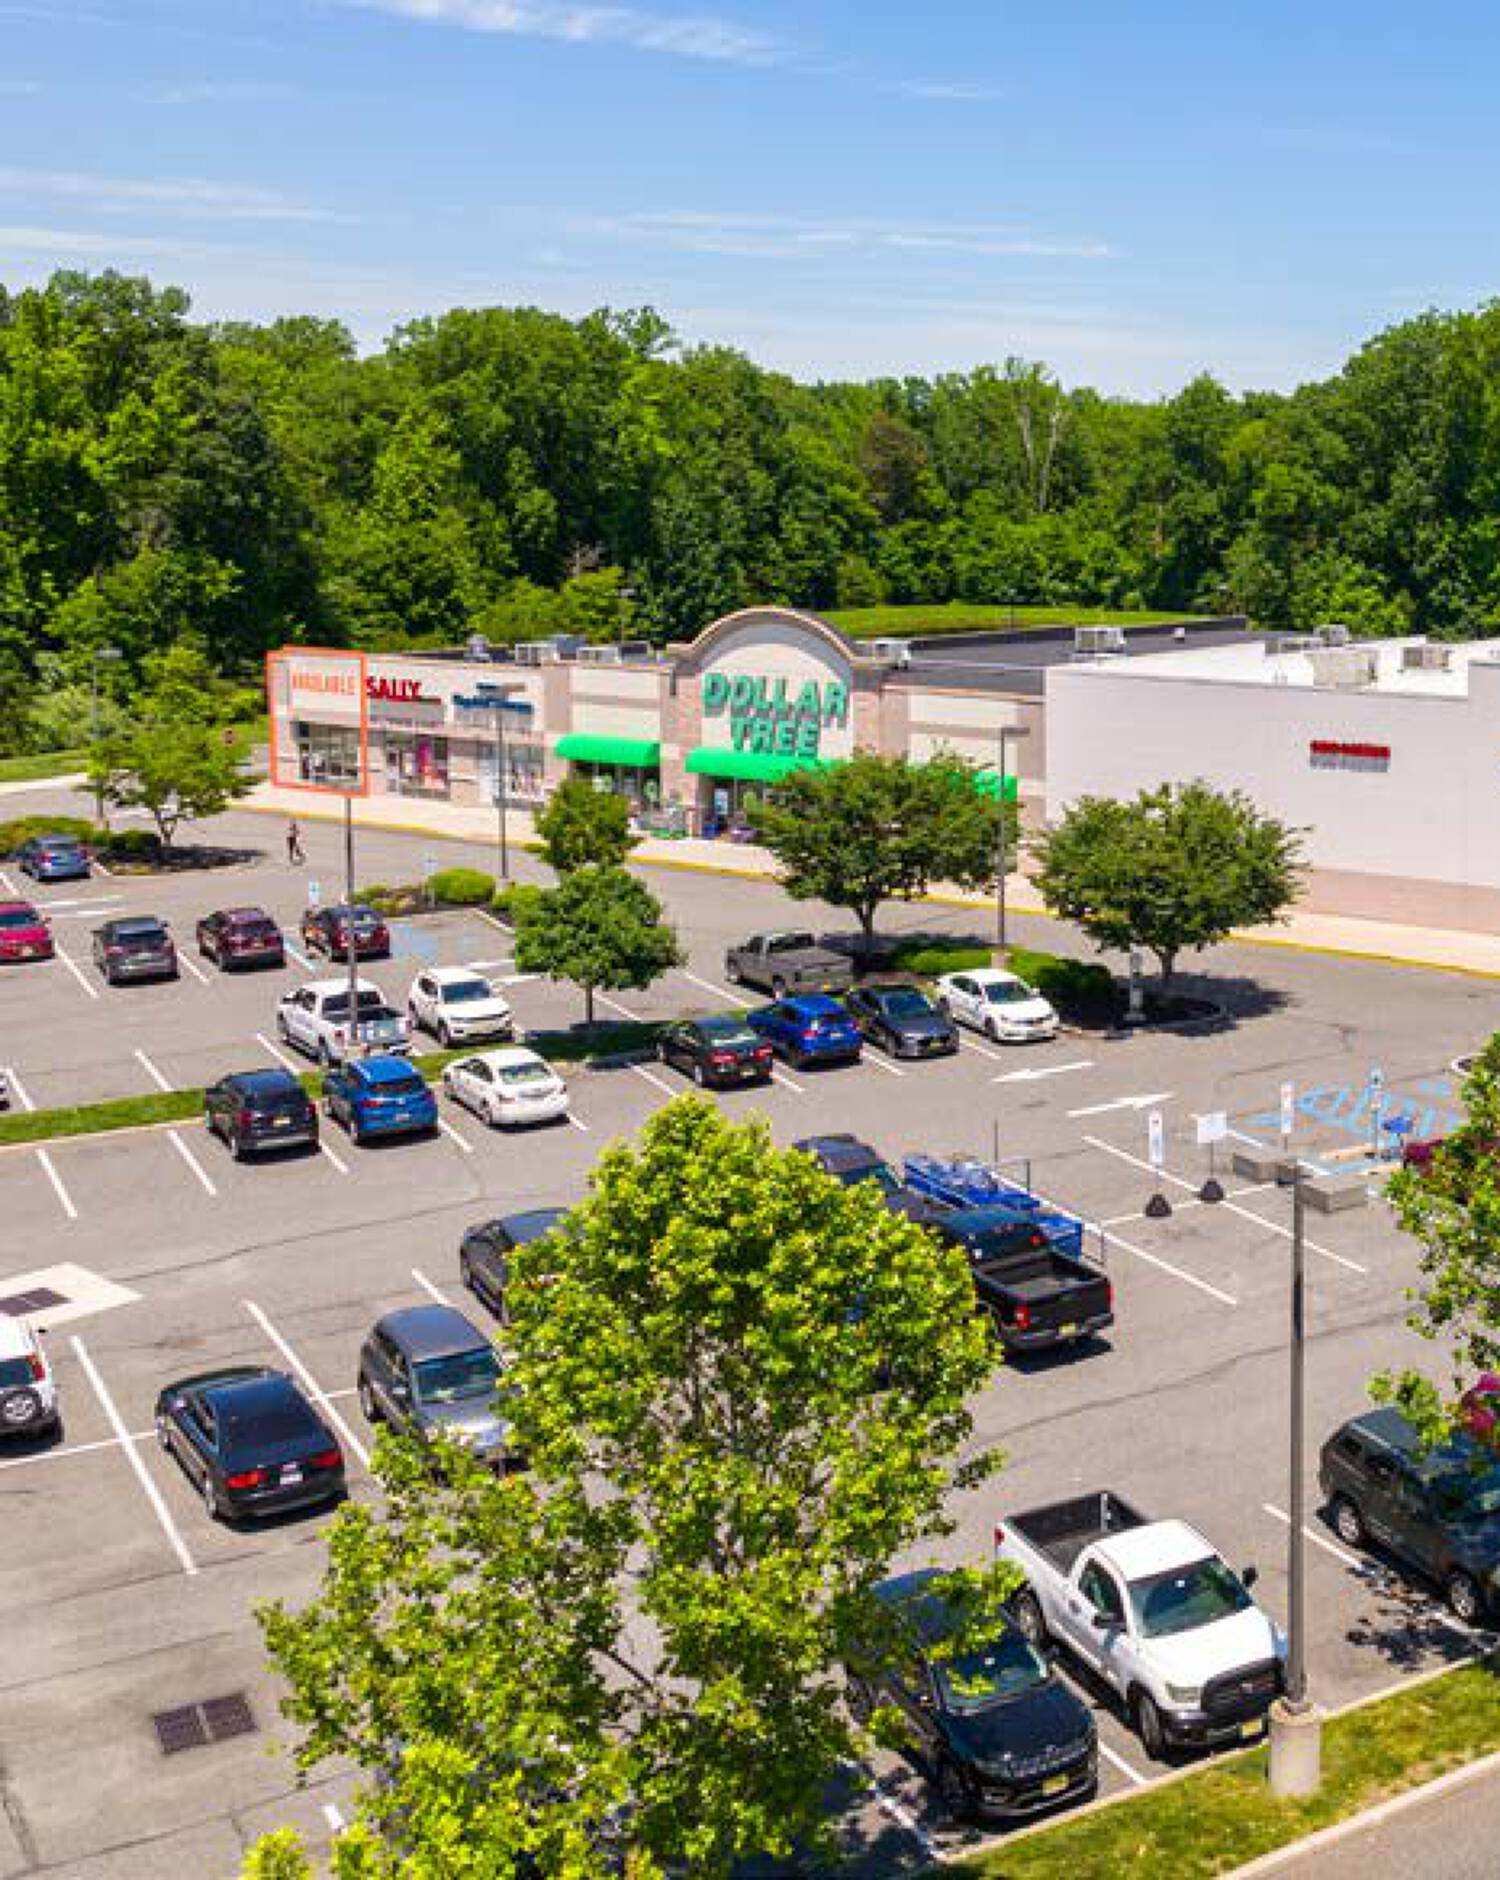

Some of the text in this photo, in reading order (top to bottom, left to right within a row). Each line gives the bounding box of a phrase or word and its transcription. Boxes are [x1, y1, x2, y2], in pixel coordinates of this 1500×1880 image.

[366, 676, 423, 700] SALLY
[703, 672, 848, 726] DOLLAR
[730, 716, 822, 758] TREE
